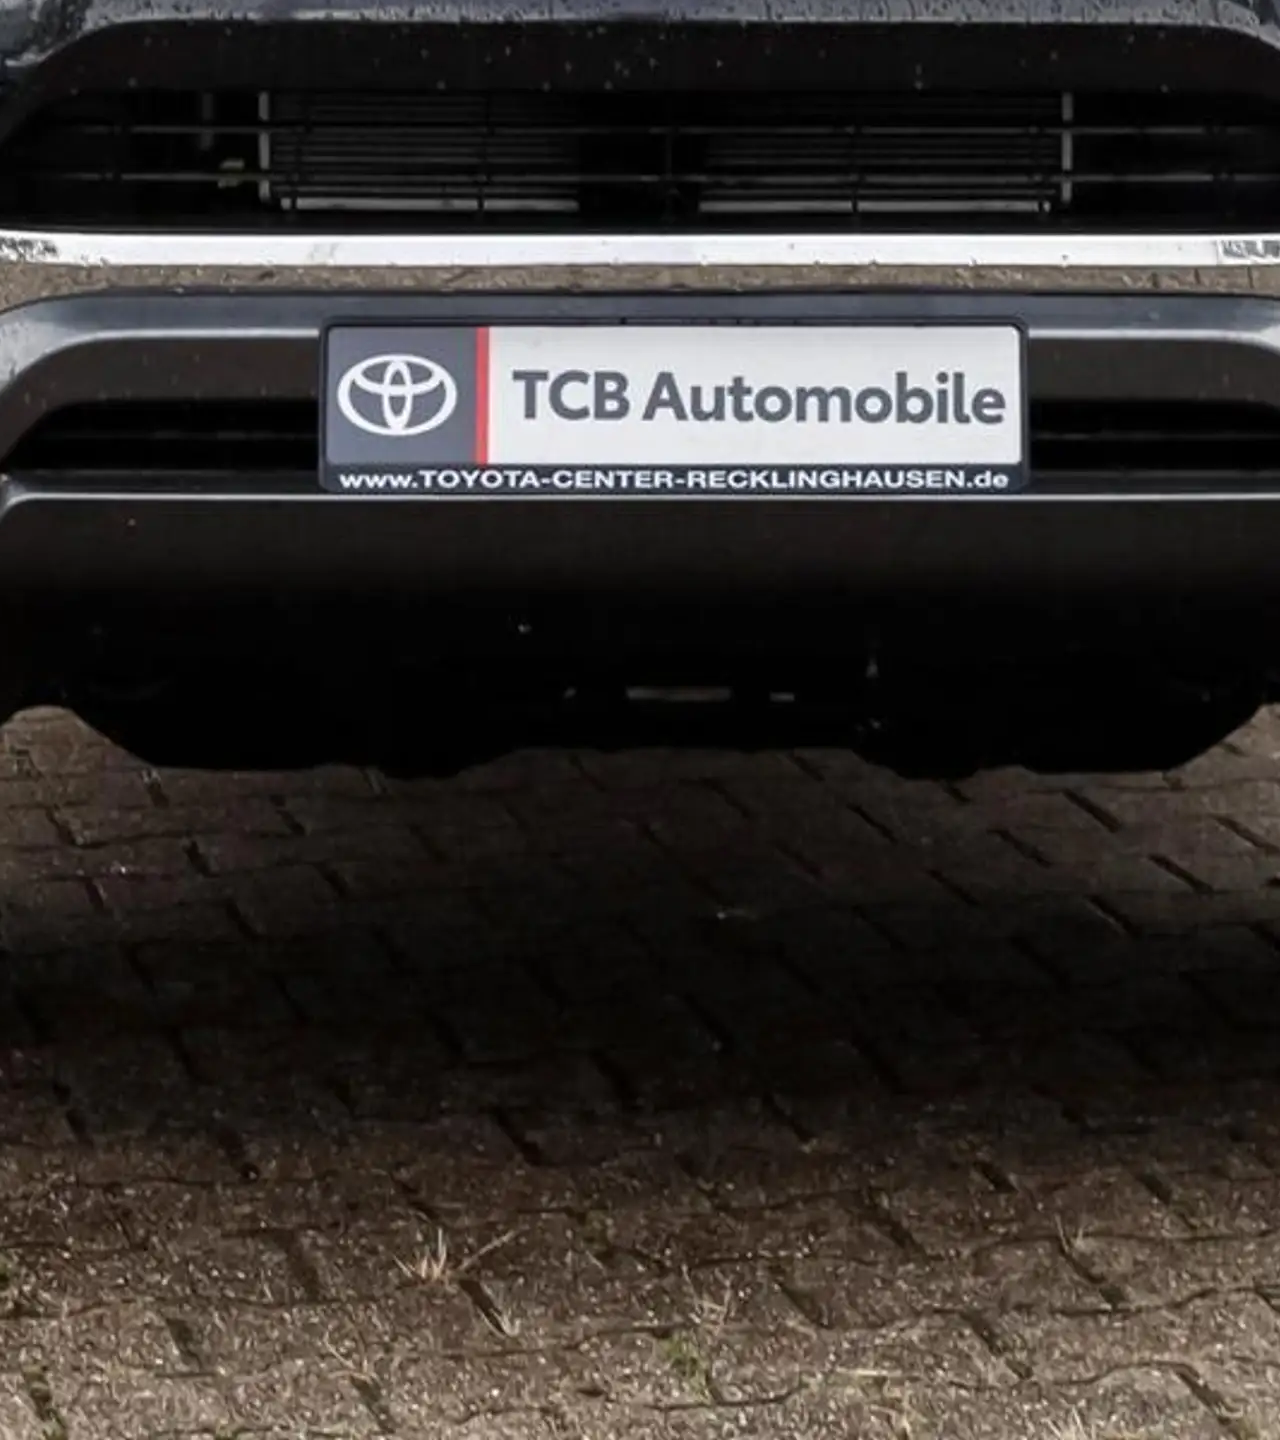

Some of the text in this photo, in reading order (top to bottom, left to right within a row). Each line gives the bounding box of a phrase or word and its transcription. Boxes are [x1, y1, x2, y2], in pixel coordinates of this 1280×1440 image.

[512, 370, 1007, 425] TCB Automobile
[338, 468, 1010, 491] www.TOYOTA-CENTER-RECKLINGHAUSEN.de
